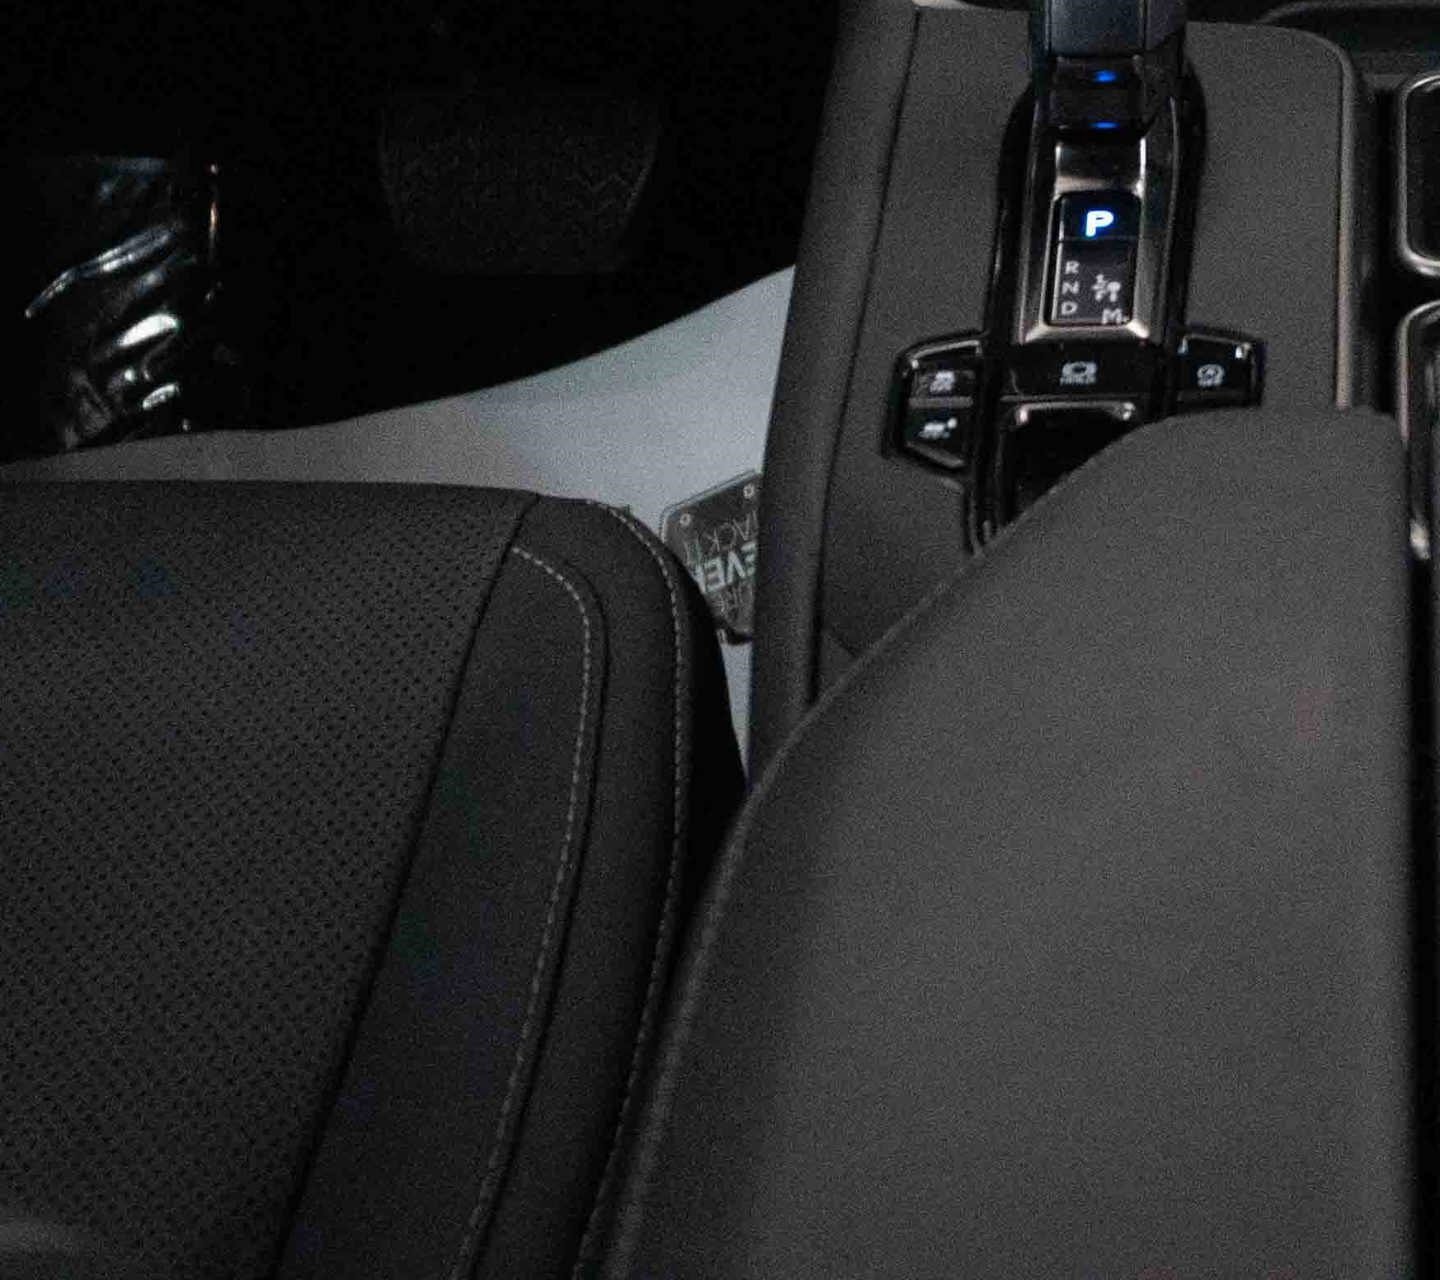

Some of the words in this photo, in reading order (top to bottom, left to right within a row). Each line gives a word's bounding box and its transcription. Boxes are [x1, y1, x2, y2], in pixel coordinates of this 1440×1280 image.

[1085, 209, 1115, 238] P
[1064, 259, 1081, 275] R
[1061, 279, 1080, 295] N
[1060, 300, 1079, 316] D
